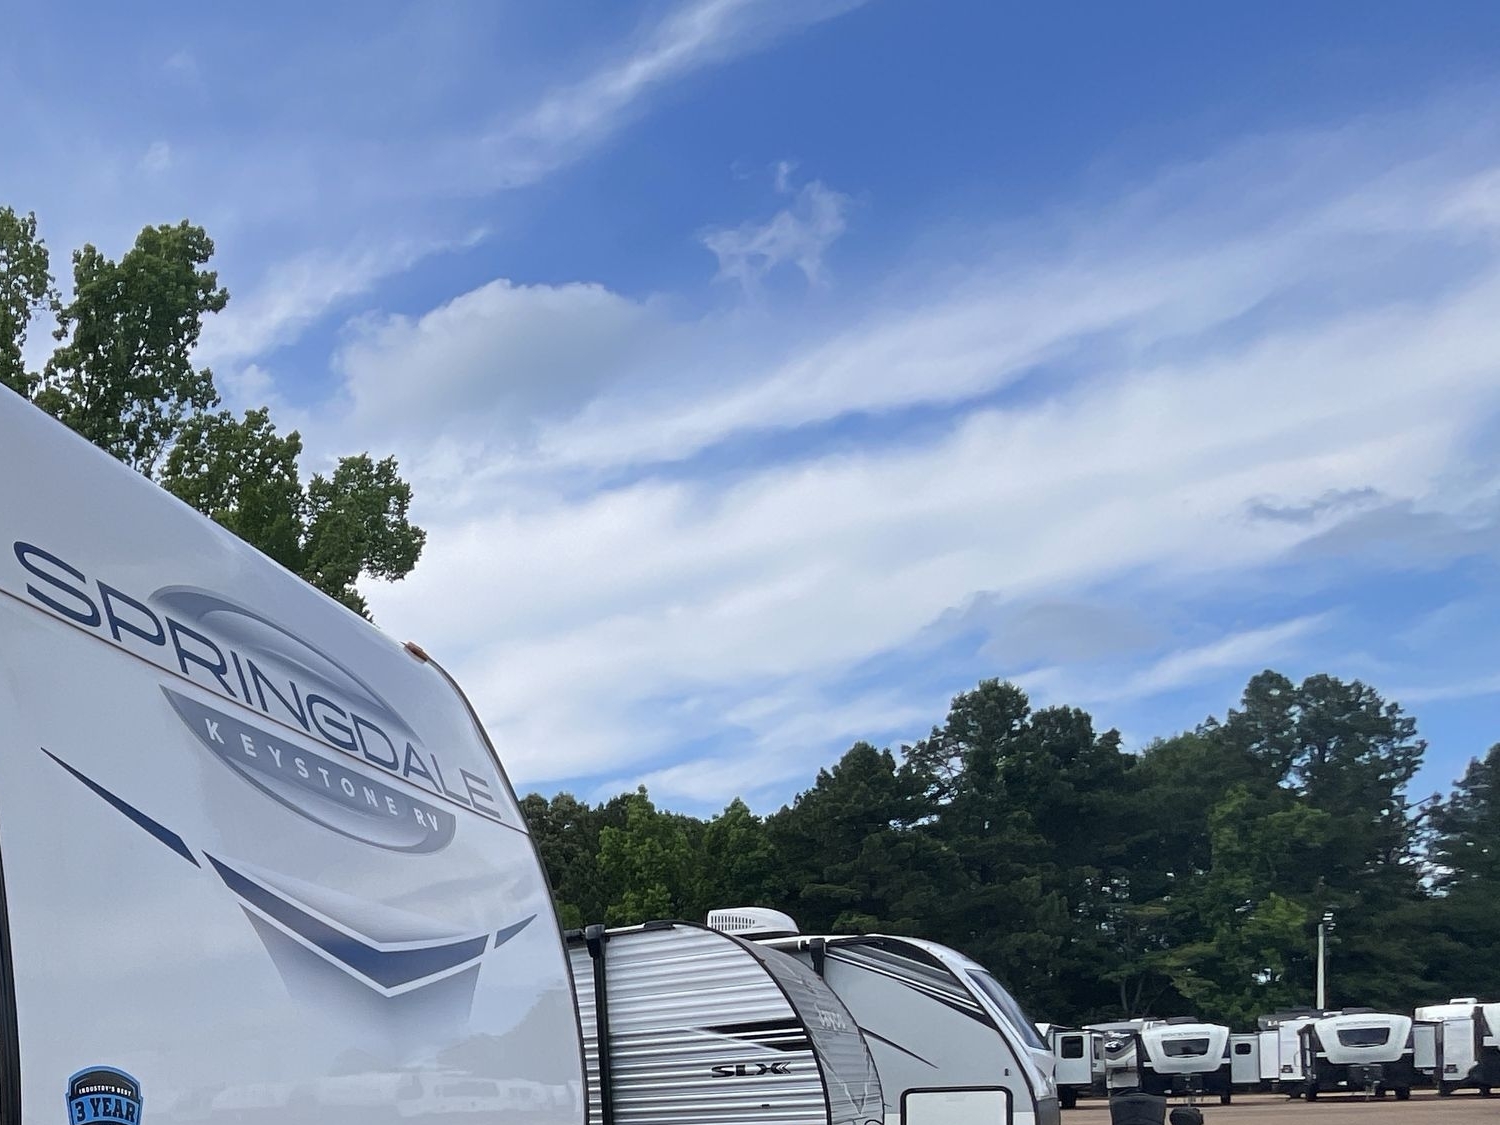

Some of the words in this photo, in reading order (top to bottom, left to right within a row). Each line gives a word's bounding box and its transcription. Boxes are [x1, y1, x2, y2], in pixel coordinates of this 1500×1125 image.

[13, 541, 500, 818] SPRINGDALE
[203, 717, 398, 817] KEYSTONE
[414, 807, 439, 832] RV
[75, 1101, 85, 1121] 3
[90, 1097, 135, 1122] YEAR
